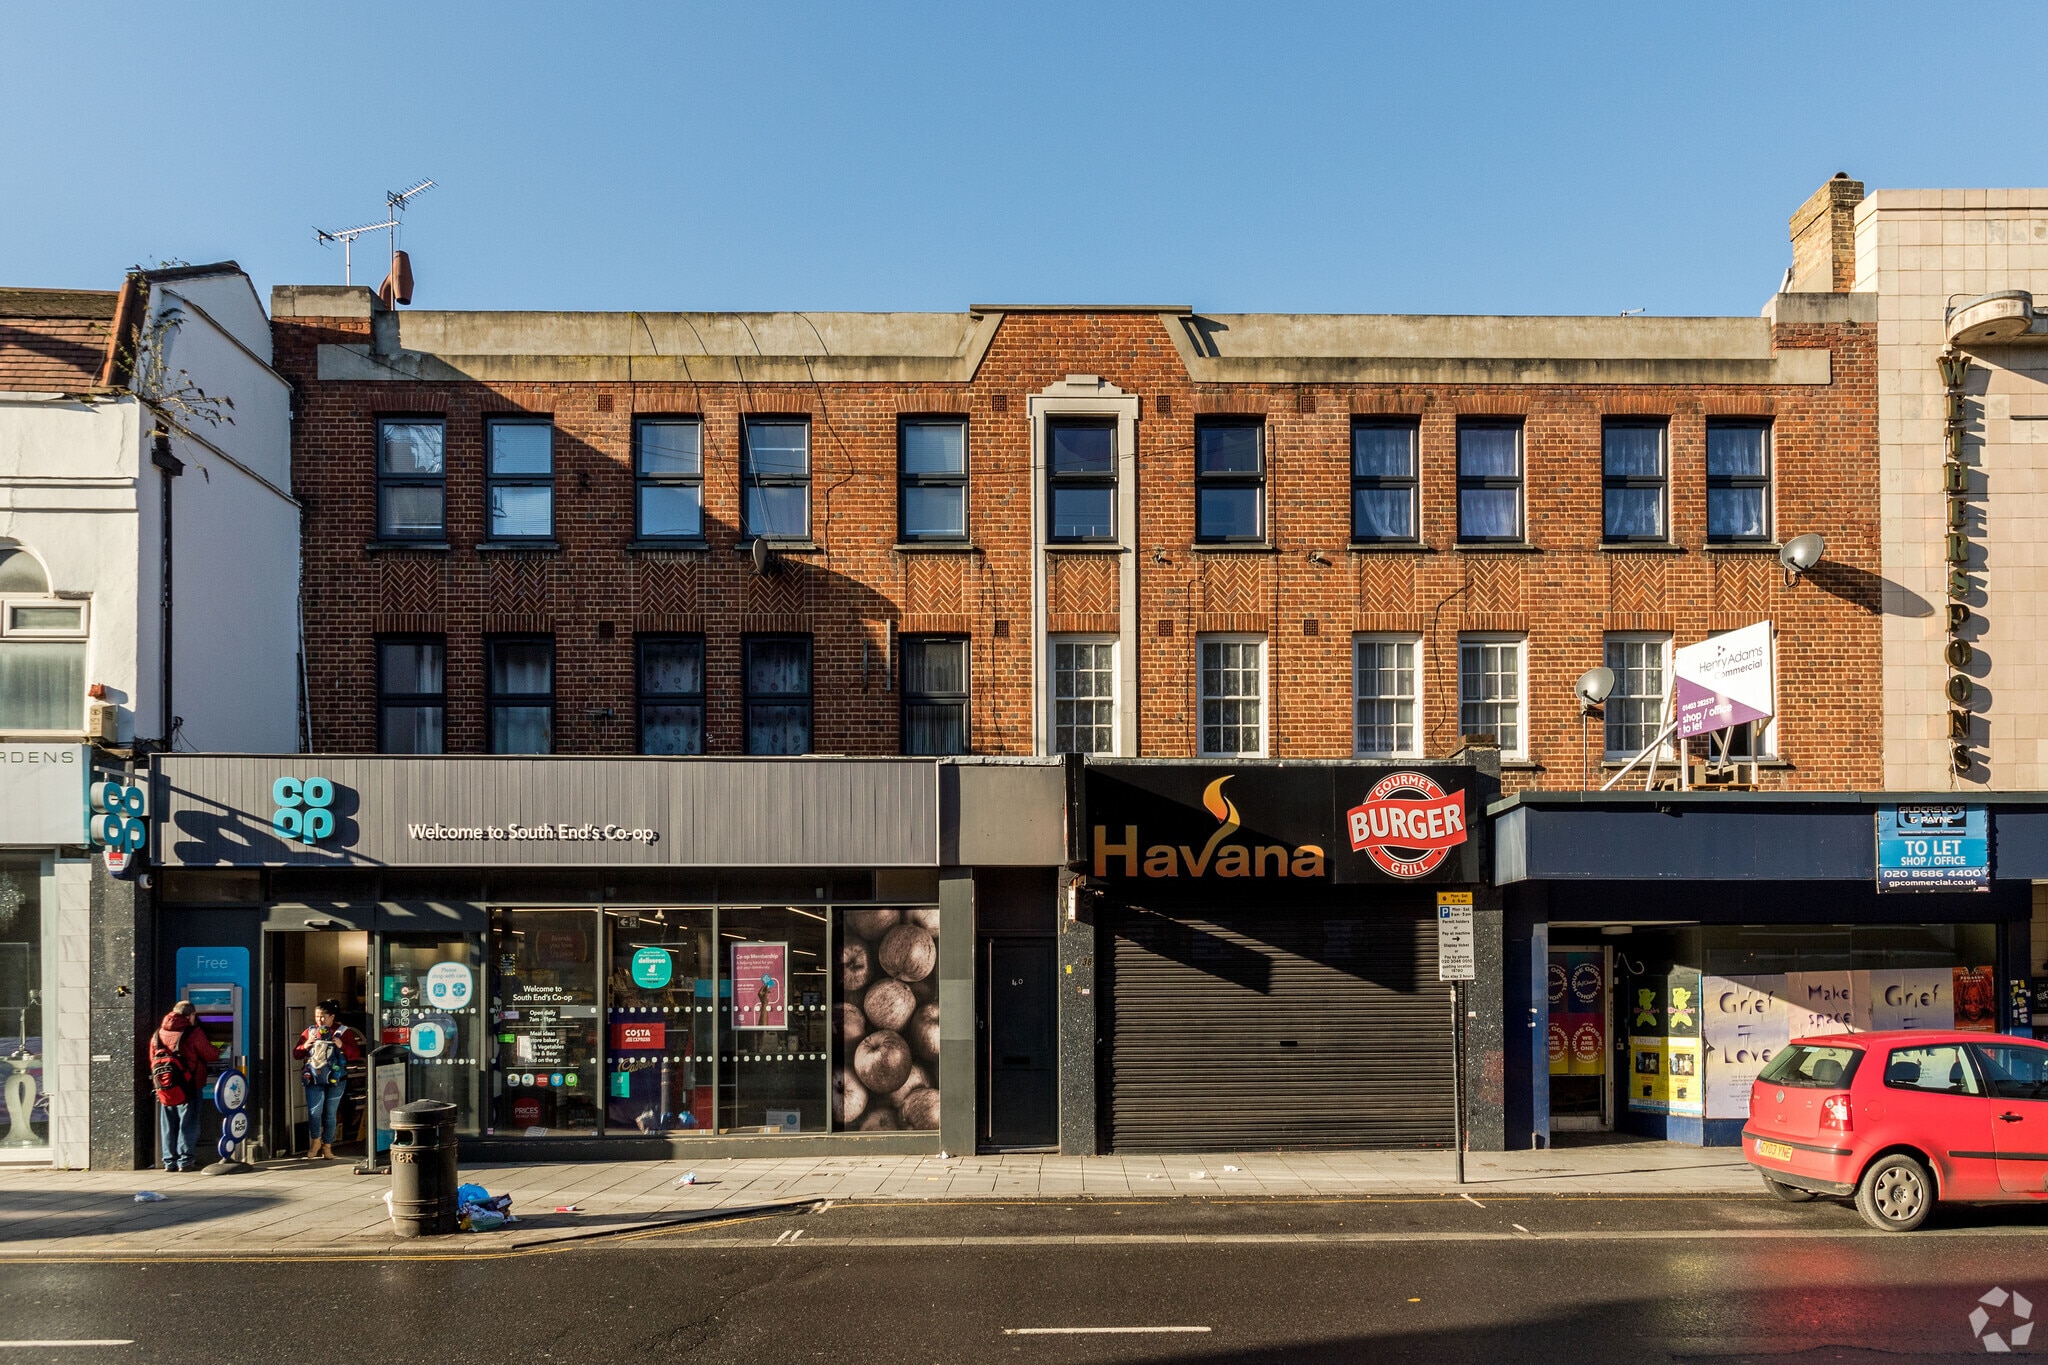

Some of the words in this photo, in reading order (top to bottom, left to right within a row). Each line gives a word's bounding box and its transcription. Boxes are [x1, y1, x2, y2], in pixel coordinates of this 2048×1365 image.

[1936, 356, 1973, 774] WETHERSPOONS
[1683, 709, 1702, 723] shop
[1709, 704, 1733, 717] office
[1683, 724, 1691, 733] to
[1692, 721, 1702, 732] let
[1375, 775, 1434, 797] GOURMET
[1898, 805, 1965, 814] GILDERSLEVE
[1350, 803, 1464, 844] BURGER
[1910, 816, 1918, 824] &
[1921, 816, 1953, 824] PAYNE
[408, 823, 484, 839] Welcome
[487, 825, 504, 839] to
[508, 823, 554, 840] South
[558, 823, 600, 840] End's
[604, 823, 654, 844] Co-op
[1093, 806, 1326, 878] Havana
[1904, 840, 1928, 856] TO
[1933, 840, 1961, 855] LET
[1391, 863, 1428, 874] GRILL
[1901, 856, 1926, 866] SHOP
[1927, 856, 1932, 867] /
[1934, 856, 1966, 865] OFFICE
[1883, 870, 1909, 878] 020
[1912, 869, 1944, 878] 8686
[1947, 869, 1981, 877] 4400
[1889, 879, 1977, 888] gpcommercial.co.uk
[1442, 908, 1449, 917] P
[197, 955, 228, 969] Free
[1011, 978, 1024, 986] 40
[1571, 967, 1584, 992] HOUSE
[1584, 966, 1602, 991] GOSPEL
[523, 985, 554, 993] Welcome
[1807, 984, 1850, 1001] Make
[1884, 983, 1940, 1007] Grief
[551, 994, 573, 1002] Co-op
[1719, 990, 1774, 1014] Grief
[543, 1009, 556, 1017] daily
[1808, 1011, 1851, 1027] space
[625, 1029, 651, 1037] COSTA
[1571, 1027, 1585, 1052] HOUSE
[1585, 1026, 1603, 1051] GOSPEL
[1724, 1045, 1772, 1064] Love
[514, 1106, 539, 1115] PRICES
